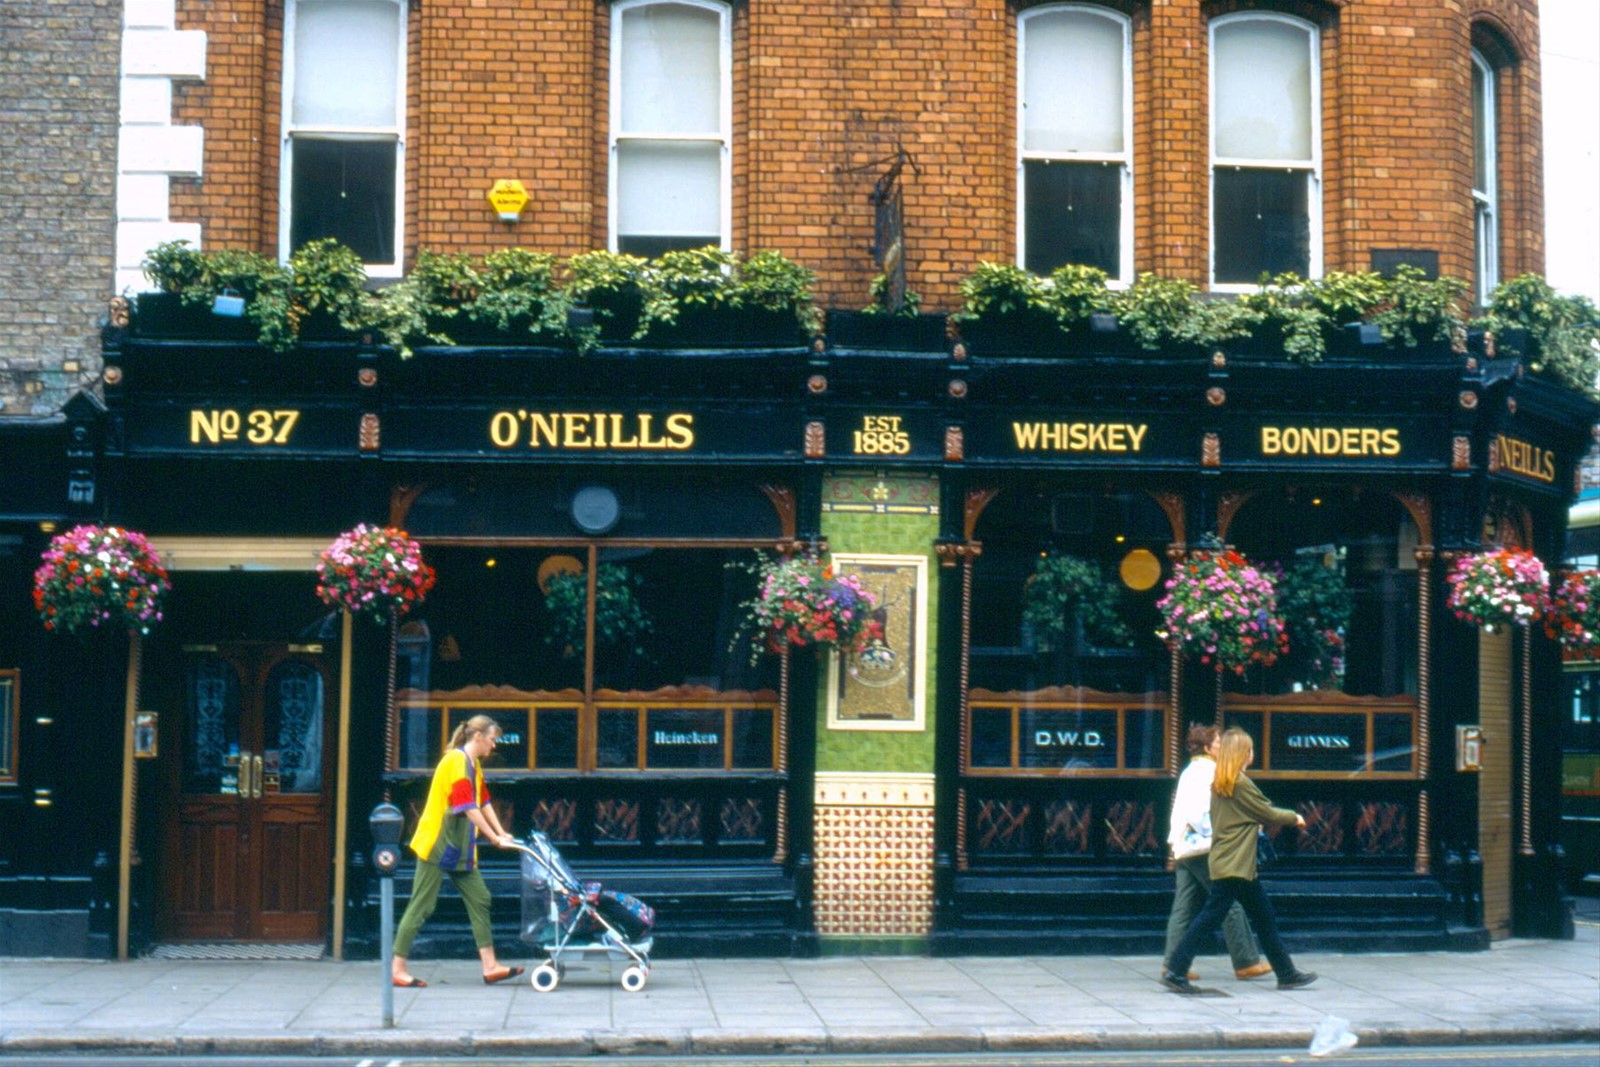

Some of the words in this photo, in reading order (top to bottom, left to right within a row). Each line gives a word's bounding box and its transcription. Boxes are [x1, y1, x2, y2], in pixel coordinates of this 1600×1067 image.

[247, 410, 299, 443] 37
[491, 410, 693, 449] O'NEILLS
[864, 415, 902, 431] EST
[855, 431, 909, 454] 1885
[1013, 423, 1147, 451] WHISKEY
[1262, 427, 1400, 455] BONDERS
[654, 731, 718, 745] Heineken
[1035, 731, 1104, 747] D.W.D.
[1287, 735, 1350, 748] GUINNESS
